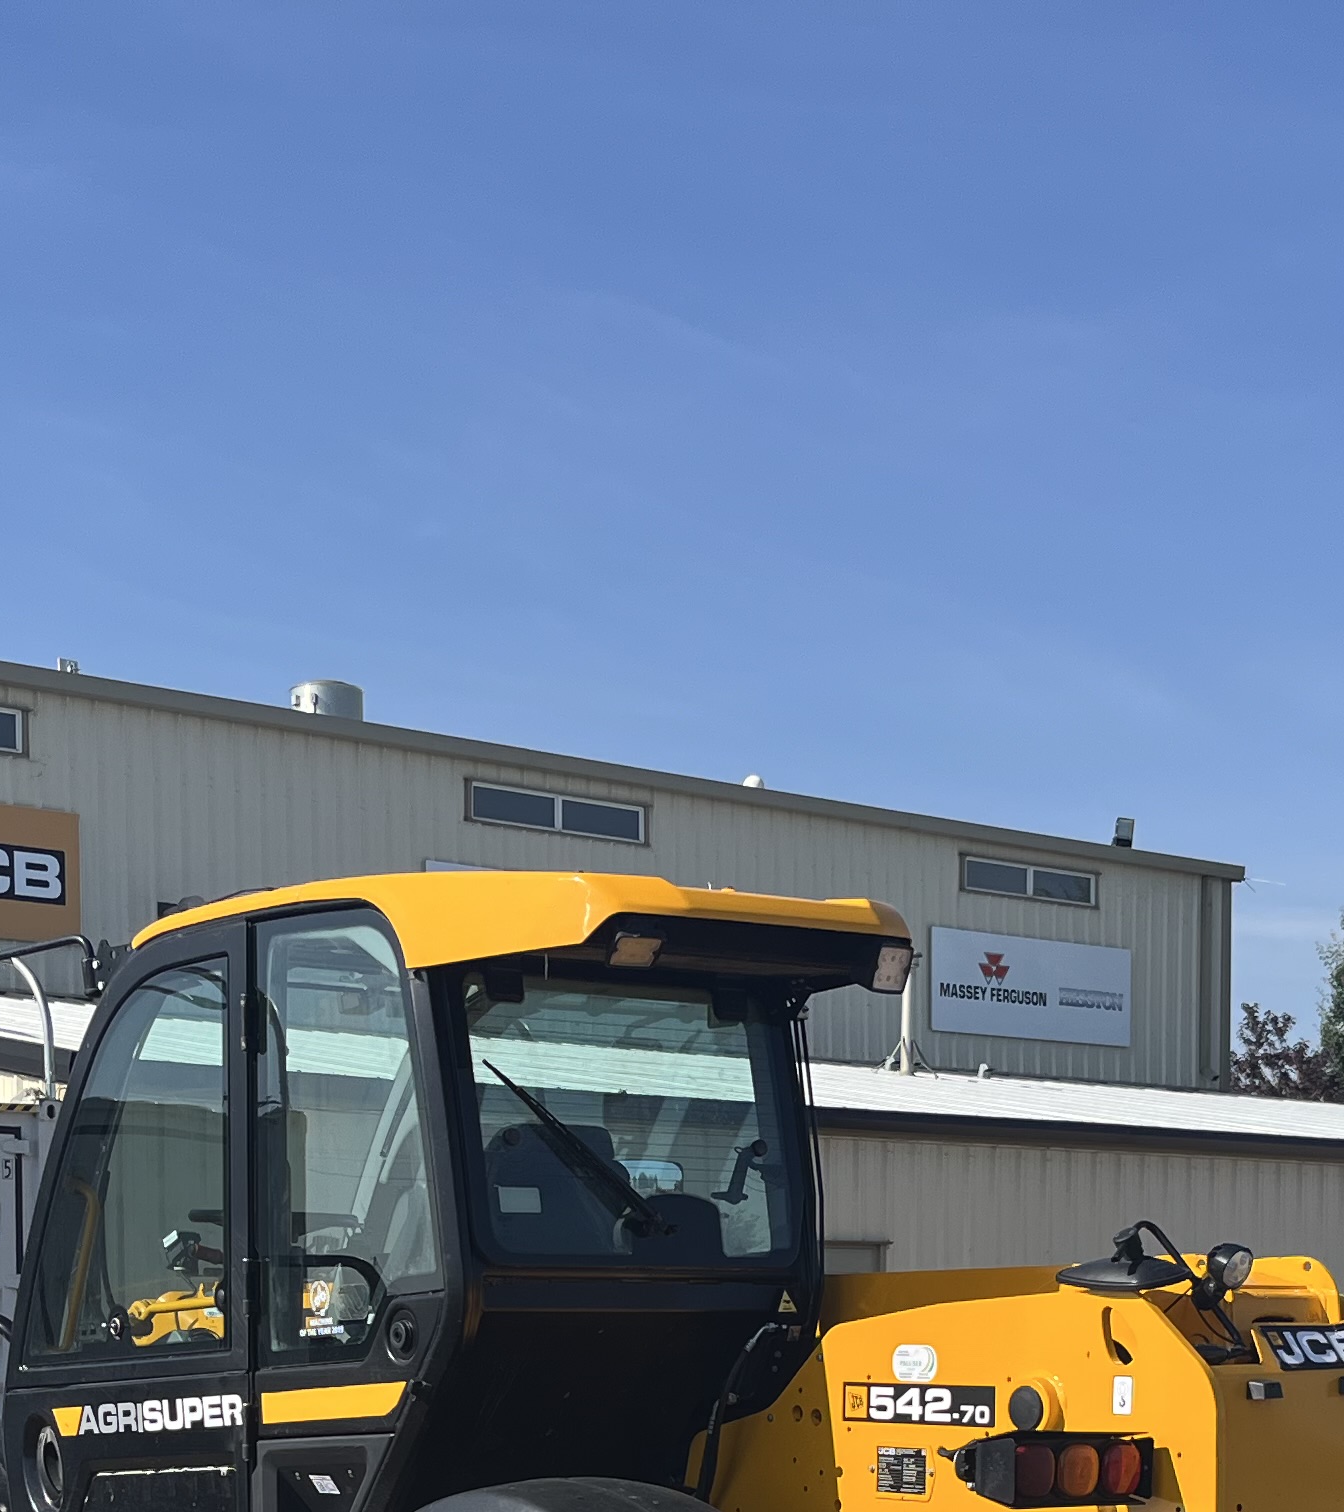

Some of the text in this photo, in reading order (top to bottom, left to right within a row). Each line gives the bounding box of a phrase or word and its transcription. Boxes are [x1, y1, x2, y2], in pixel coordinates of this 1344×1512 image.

[940, 982, 988, 1001] MASSEY
[990, 987, 1047, 1007] FERGUSON
[3, 1159, 11, 1178] 5
